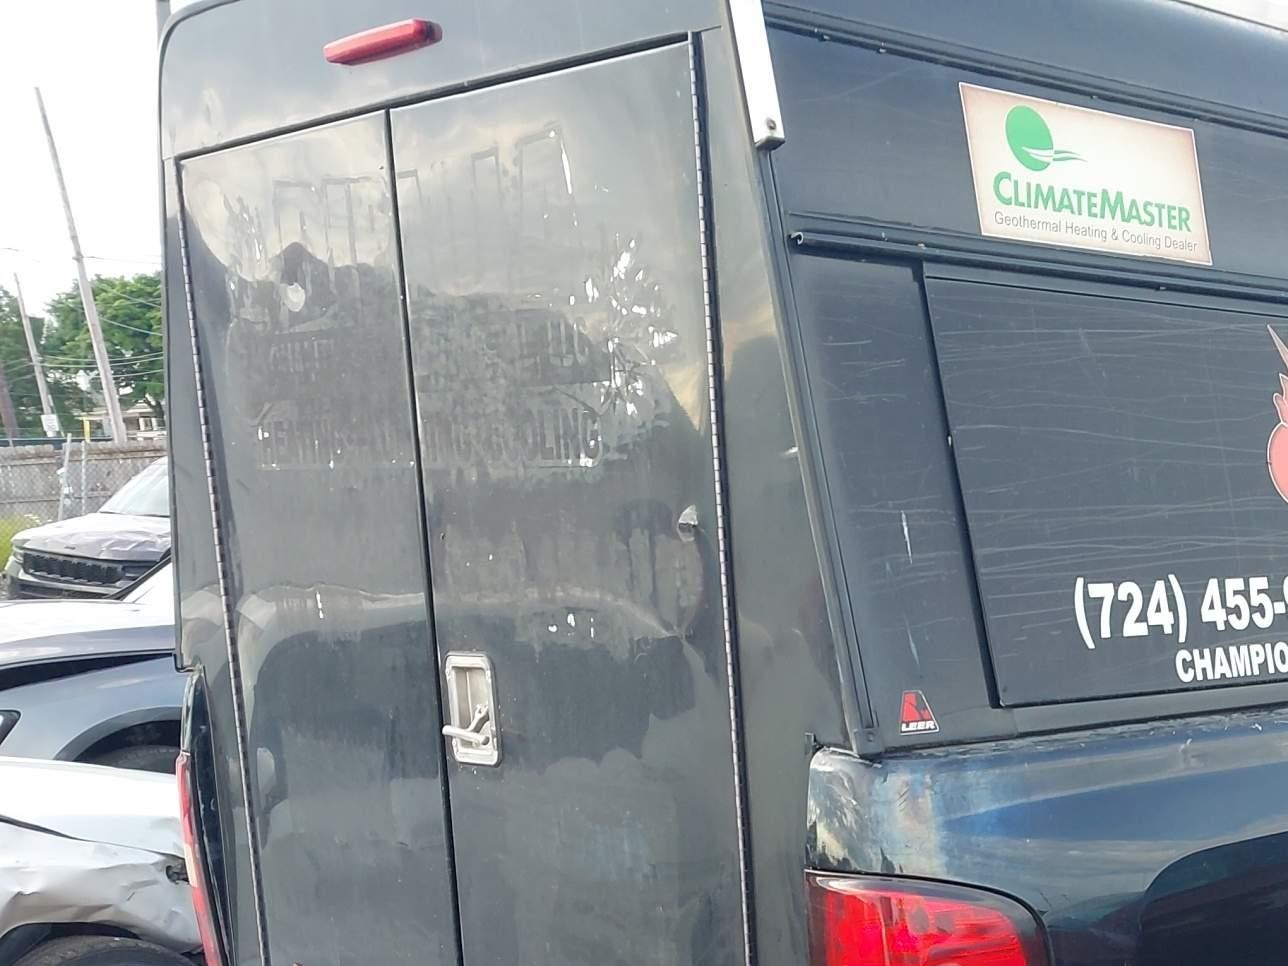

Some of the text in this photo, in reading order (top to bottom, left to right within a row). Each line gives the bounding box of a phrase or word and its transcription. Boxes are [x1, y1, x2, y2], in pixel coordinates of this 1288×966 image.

[994, 211, 1199, 251] Geothermal Heating & Cooling Dealer
[1073, 573, 1187, 650] (724)
[901, 721, 935, 732] LEER
